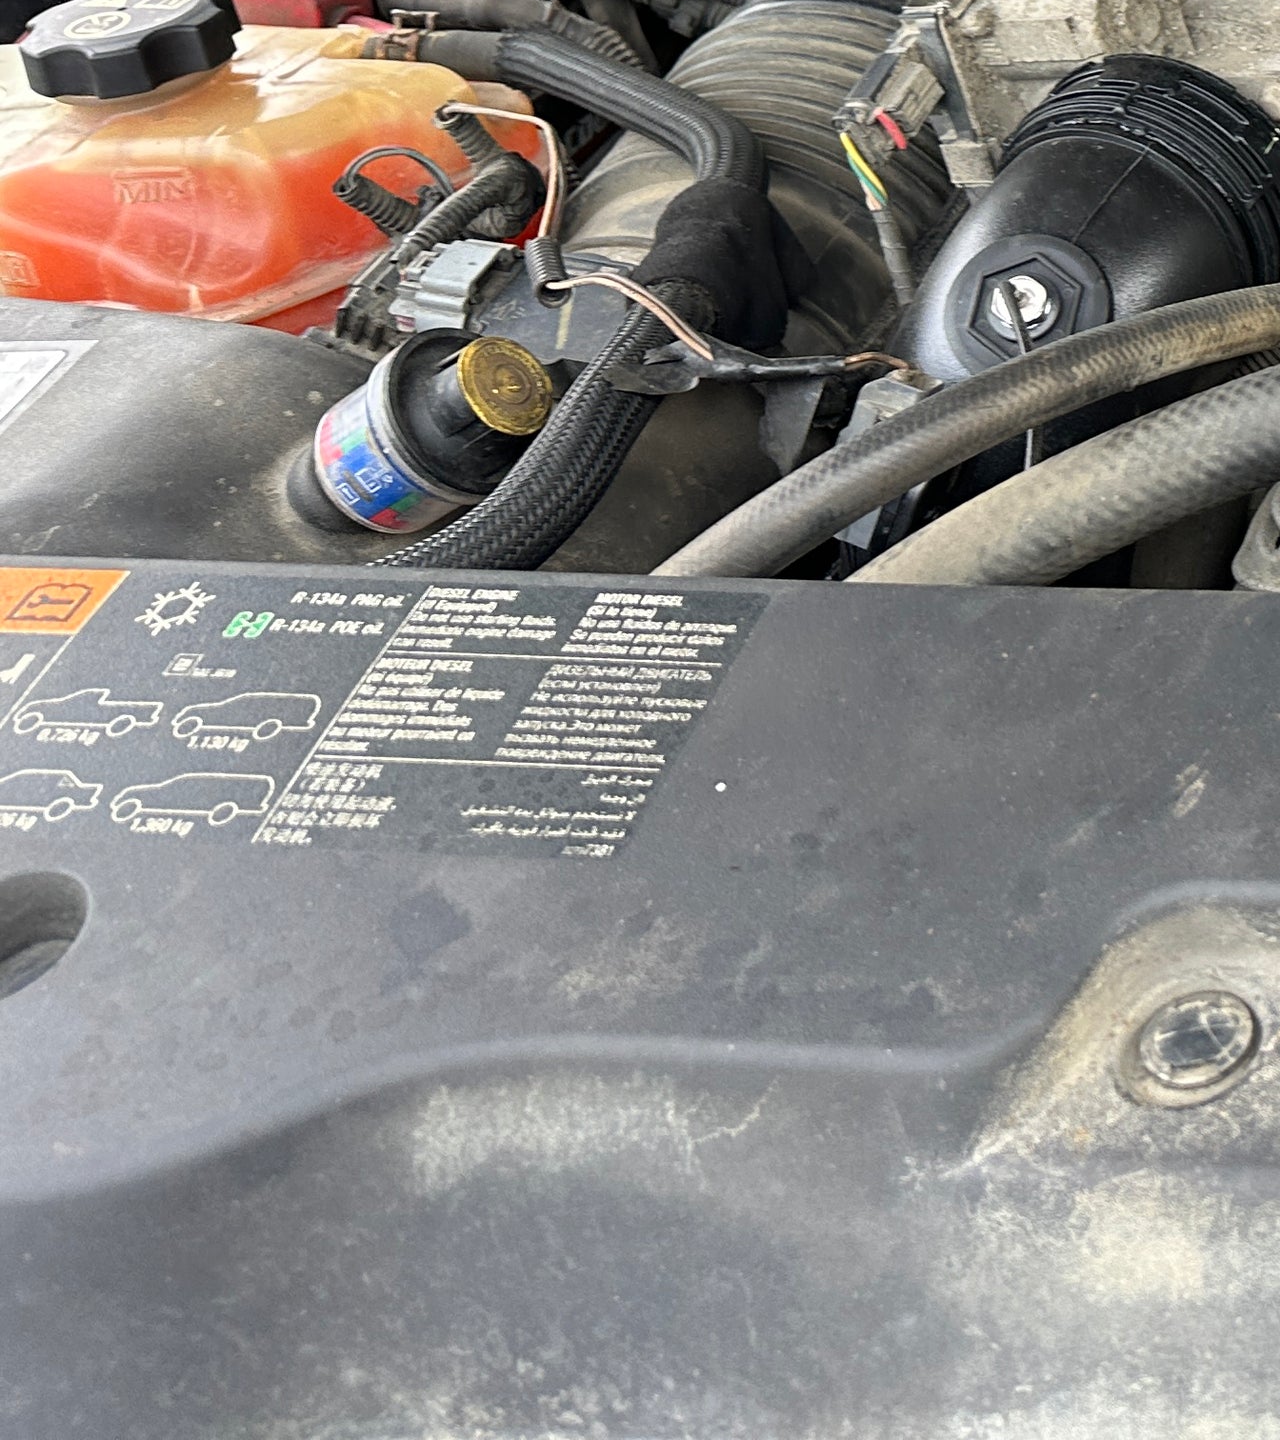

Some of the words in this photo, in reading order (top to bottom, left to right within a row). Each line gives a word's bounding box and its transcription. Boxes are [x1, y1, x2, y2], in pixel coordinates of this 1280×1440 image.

[118, 179, 193, 204] MIN
[289, 591, 347, 605] R-134a
[269, 618, 326, 632] R-134a
[328, 620, 364, 634] POE
